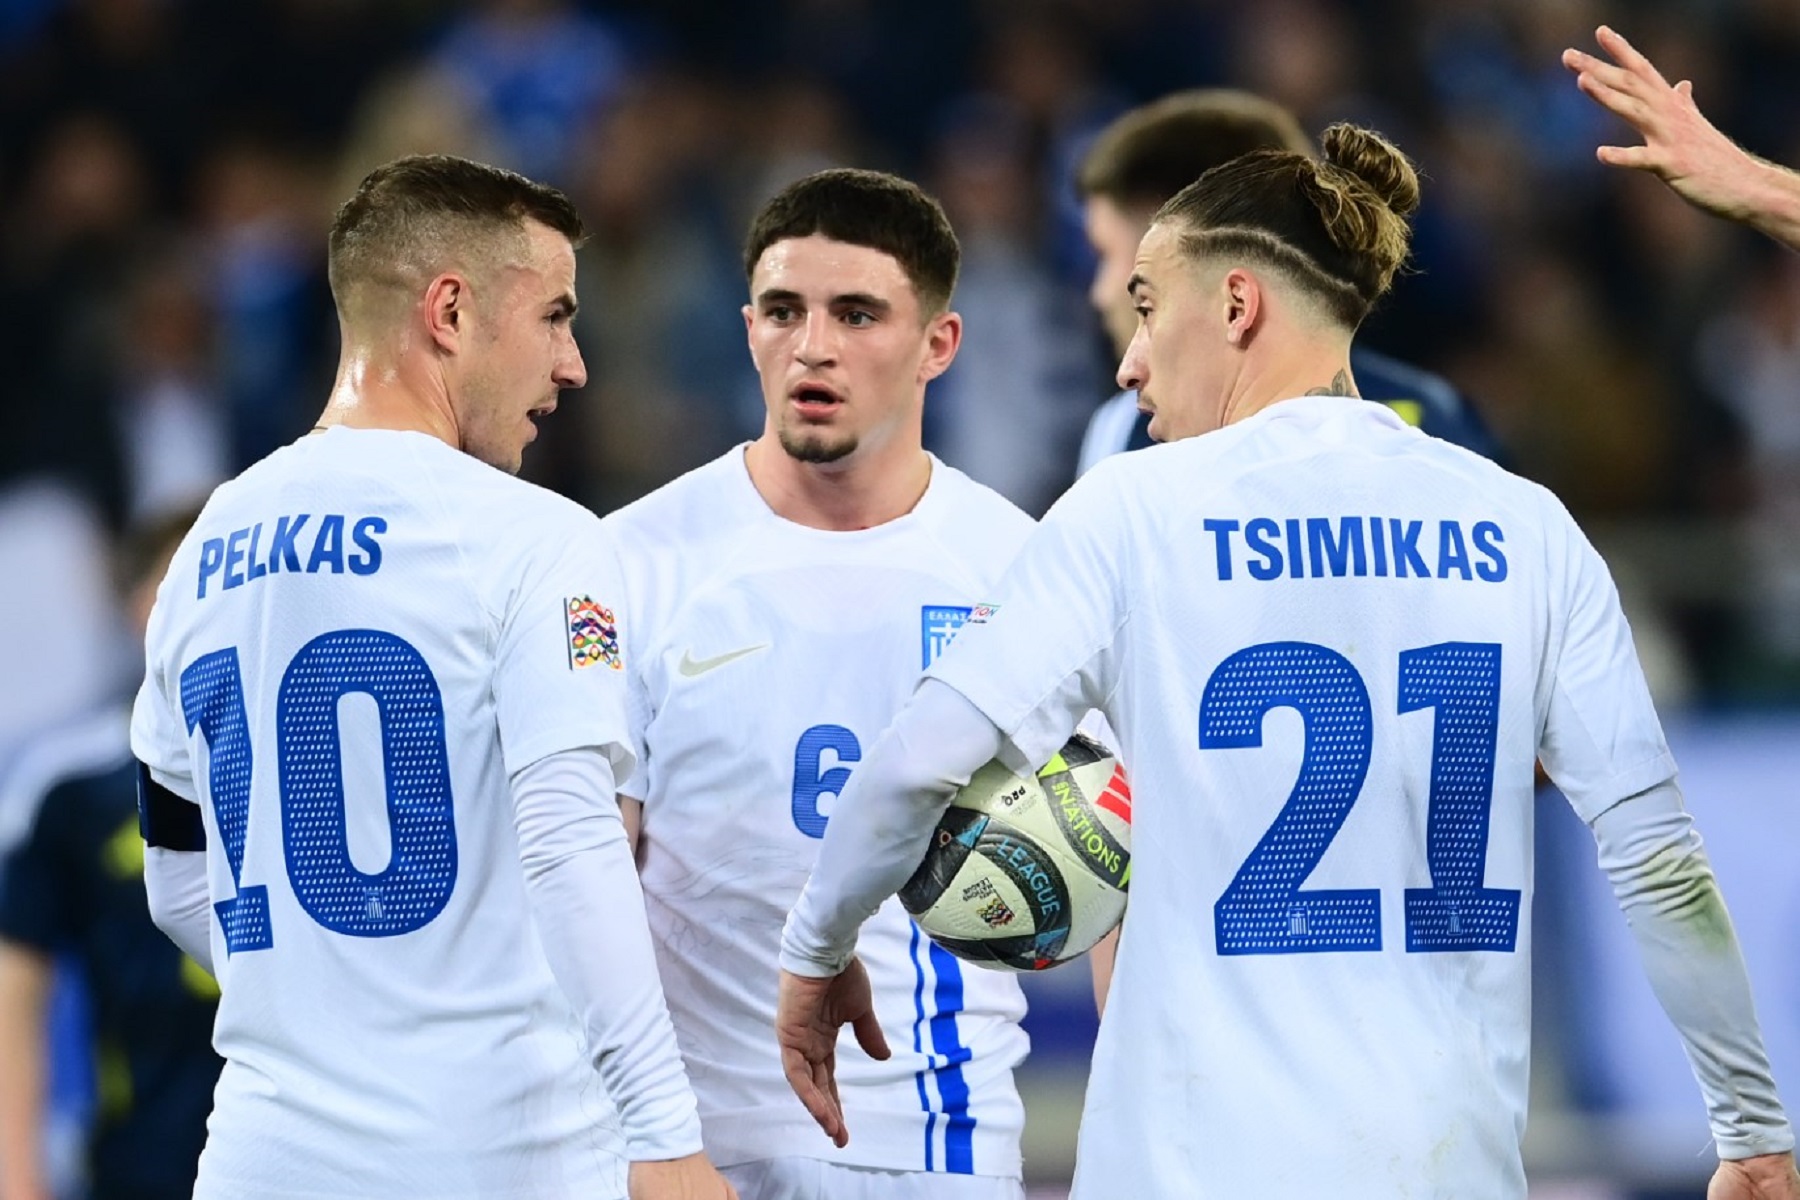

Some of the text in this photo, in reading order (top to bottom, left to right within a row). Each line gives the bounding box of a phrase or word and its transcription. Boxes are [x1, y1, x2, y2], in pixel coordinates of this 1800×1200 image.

[197, 514, 388, 600] PELKAS
[1203, 516, 1508, 582] TSIMIKAS
[180, 628, 459, 957] 10
[791, 724, 862, 840] 6
[1198, 641, 1522, 956] 21
[1054, 787, 1121, 873] NATIONS
[996, 837, 1061, 917] LEAGUE
